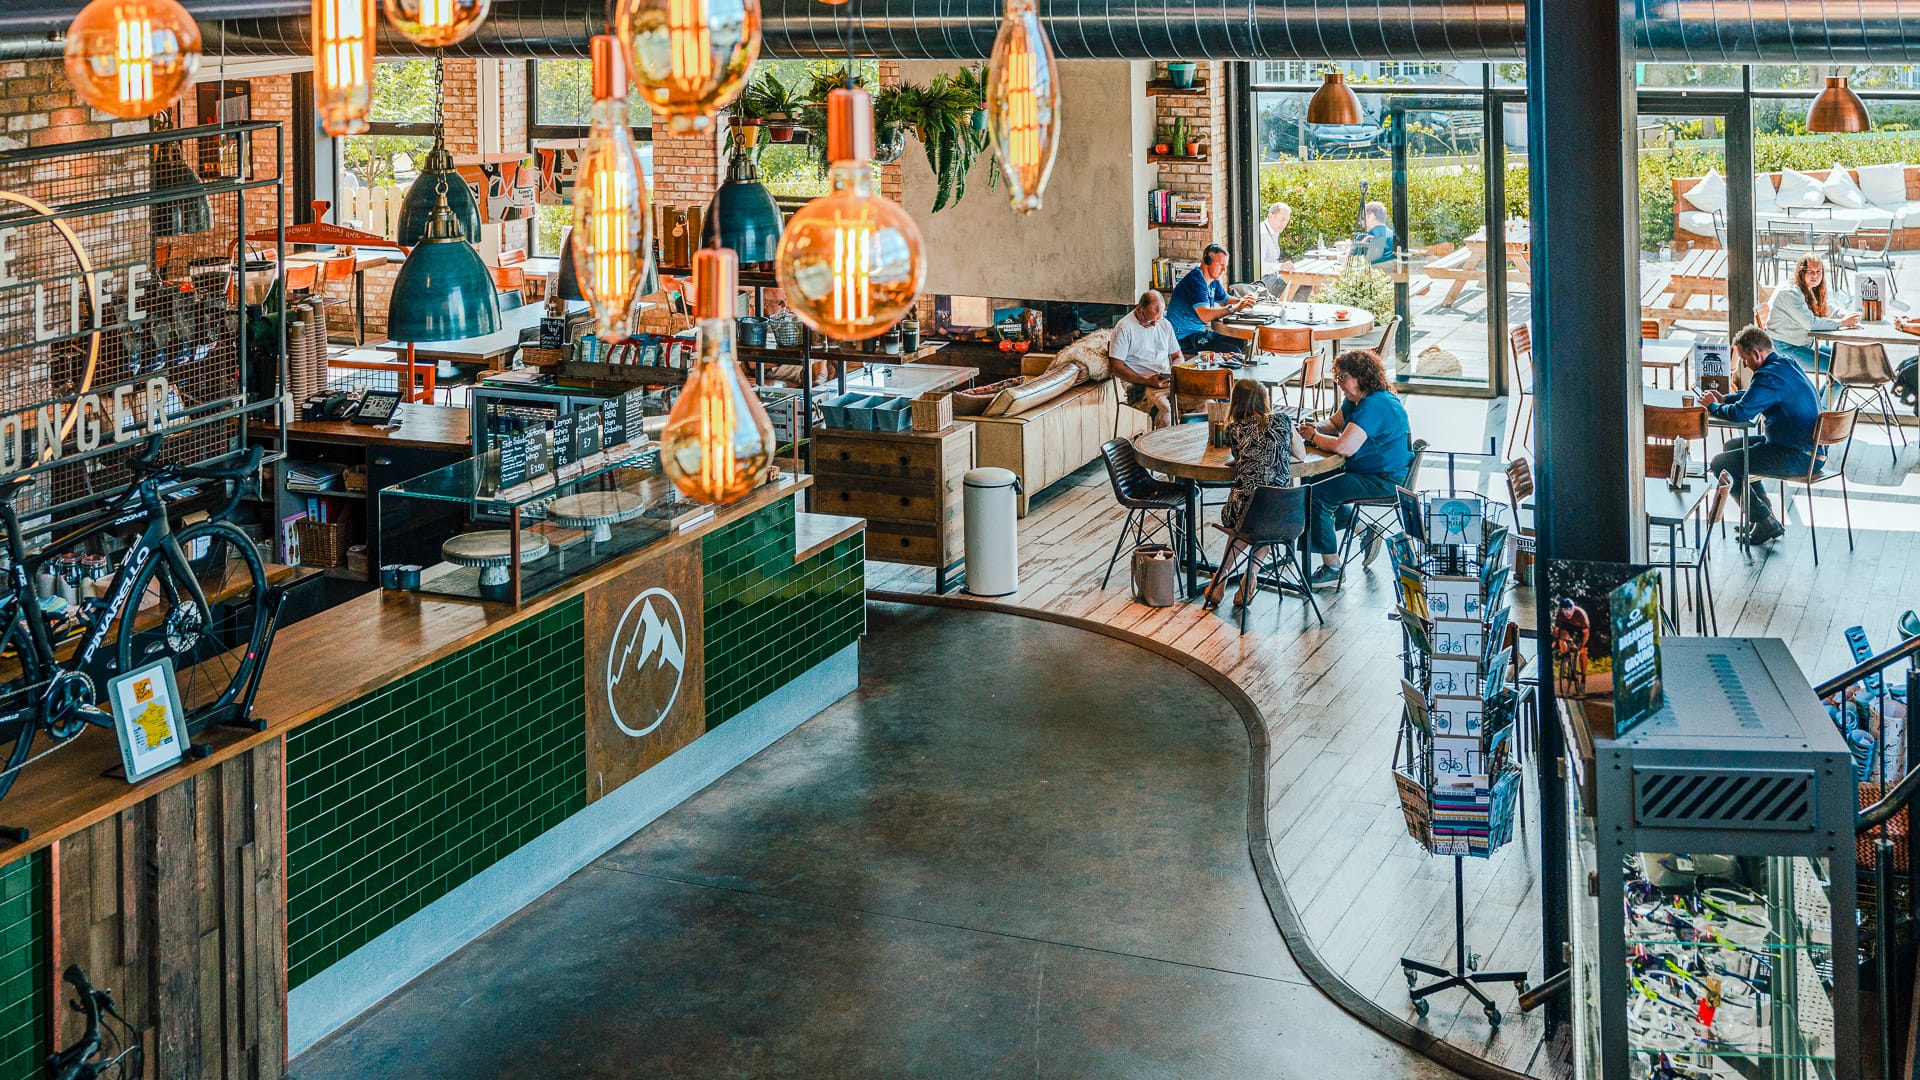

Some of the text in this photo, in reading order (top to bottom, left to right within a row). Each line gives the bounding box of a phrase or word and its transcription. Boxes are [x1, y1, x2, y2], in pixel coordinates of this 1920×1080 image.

[35, 264, 147, 342] LIFE
[0, 377, 169, 475] ONGER
[554, 417, 573, 429] Lemon
[604, 409, 617, 420] BBQ
[583, 437, 592, 448] £7
[558, 456, 568, 466] £6
[83, 545, 150, 664] PINARELLO
[1618, 619, 1654, 652] BREAKING
[1624, 645, 1655, 672] GROUND
